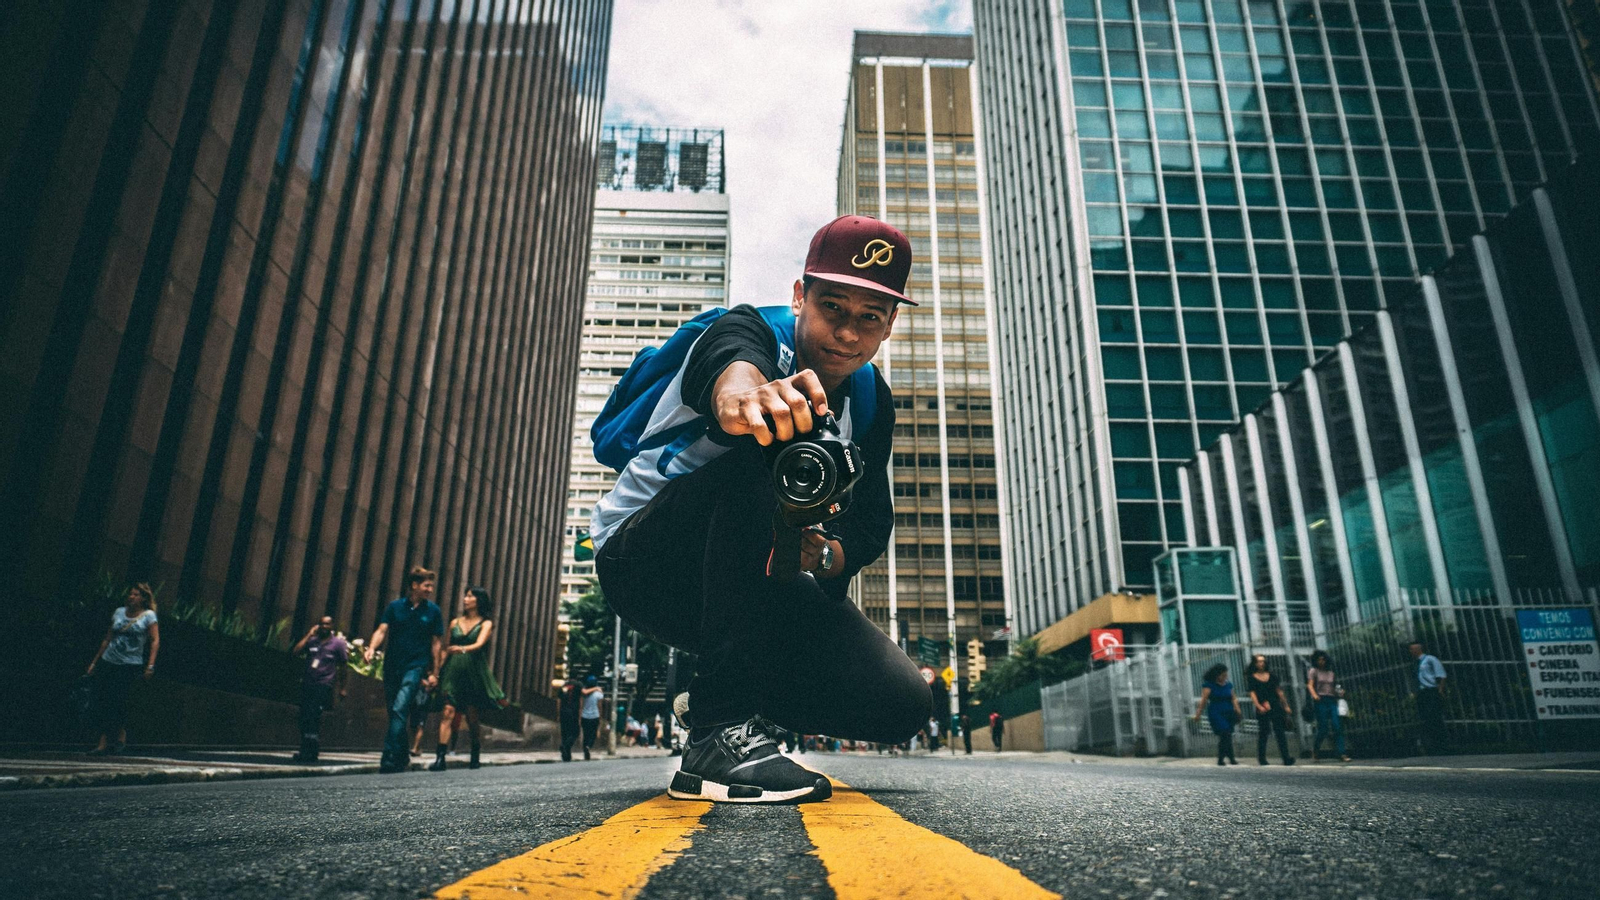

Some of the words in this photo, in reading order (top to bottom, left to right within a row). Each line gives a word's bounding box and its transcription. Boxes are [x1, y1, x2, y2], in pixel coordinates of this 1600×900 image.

[844, 449, 855, 473] Canon
[1539, 612, 1572, 624] TEMOS
[1539, 642, 1593, 655] CARTÓRIO
[1538, 658, 1580, 670] CINEMA
[1540, 671, 1580, 684] ESPAÇO
